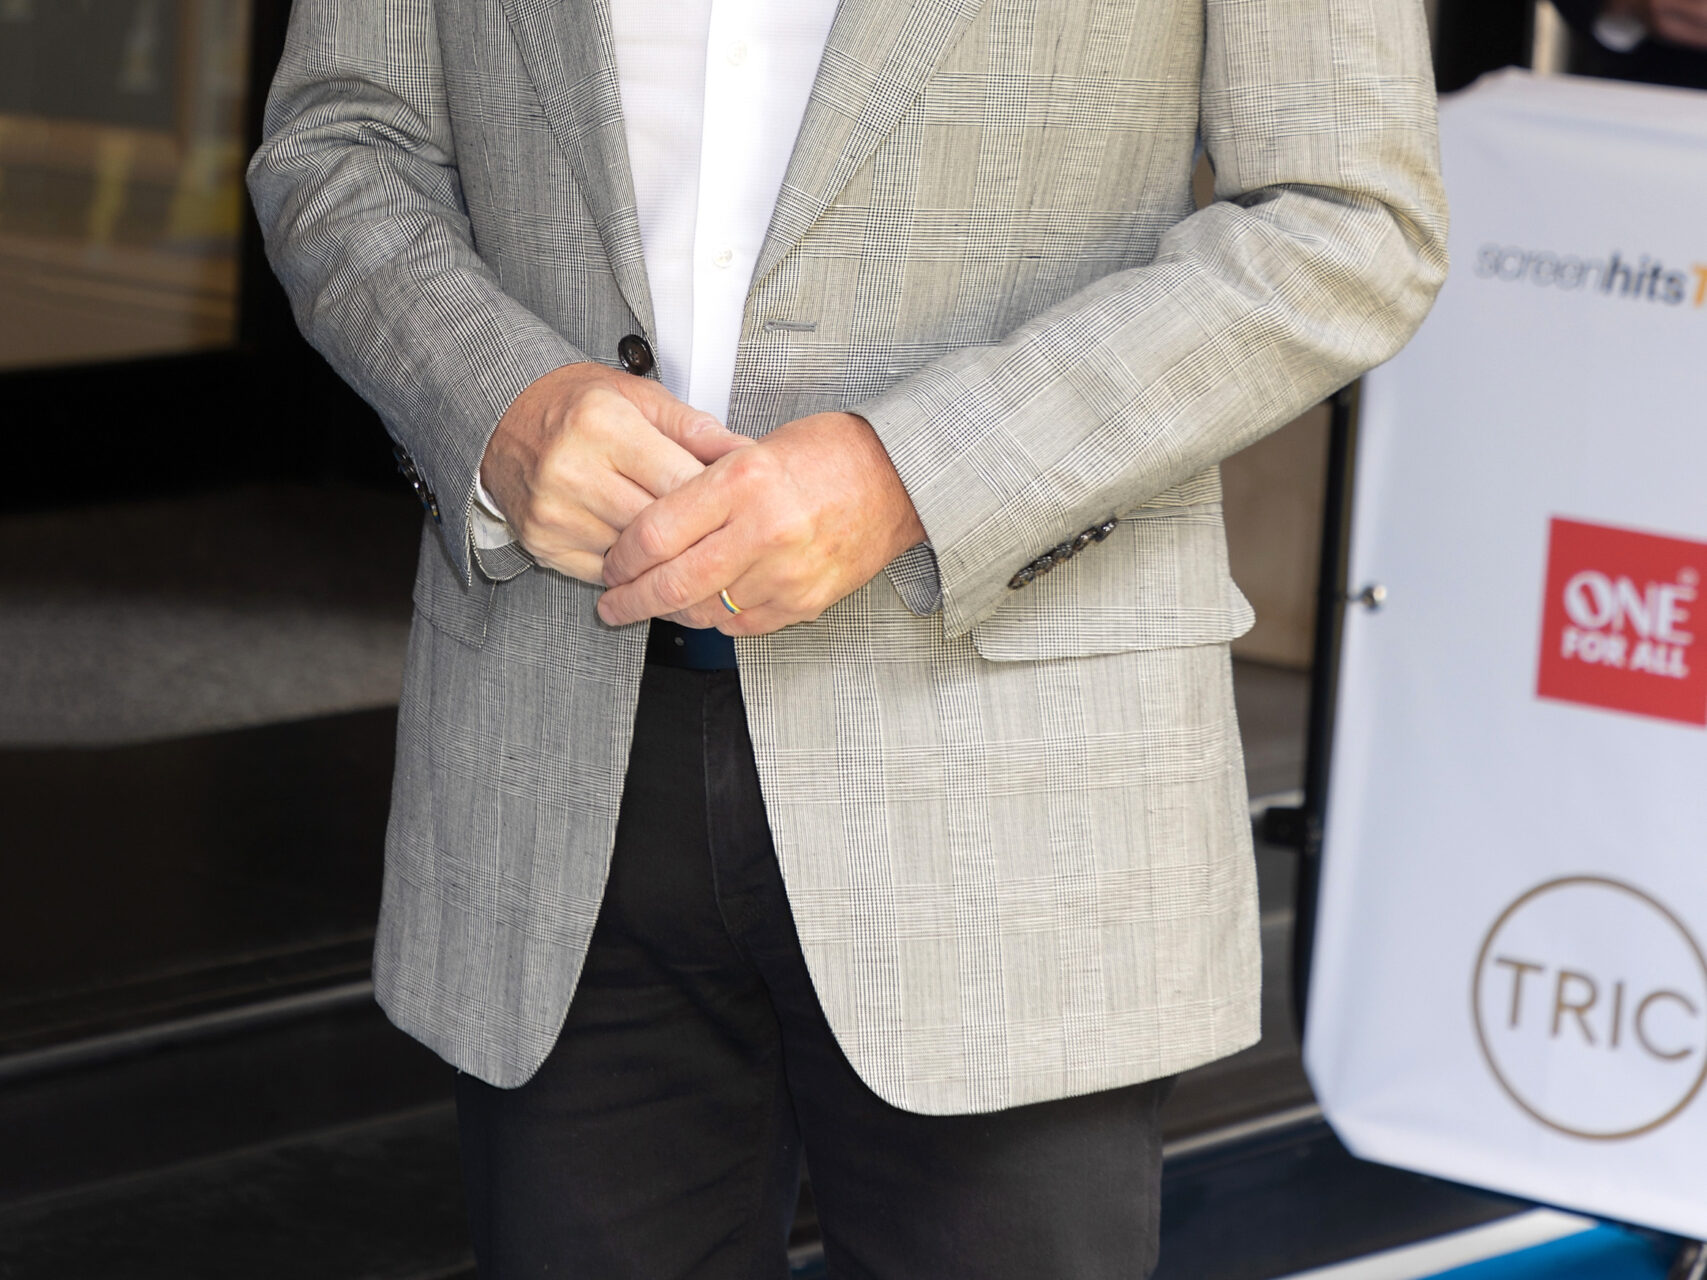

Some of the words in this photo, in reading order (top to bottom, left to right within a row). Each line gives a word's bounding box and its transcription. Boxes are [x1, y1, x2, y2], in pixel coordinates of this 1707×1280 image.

[1563, 570, 1696, 645] ONE
[1561, 625, 1627, 668] FOR
[1630, 639, 1690, 679] ALL
[1495, 956, 1698, 1061] TRIC
